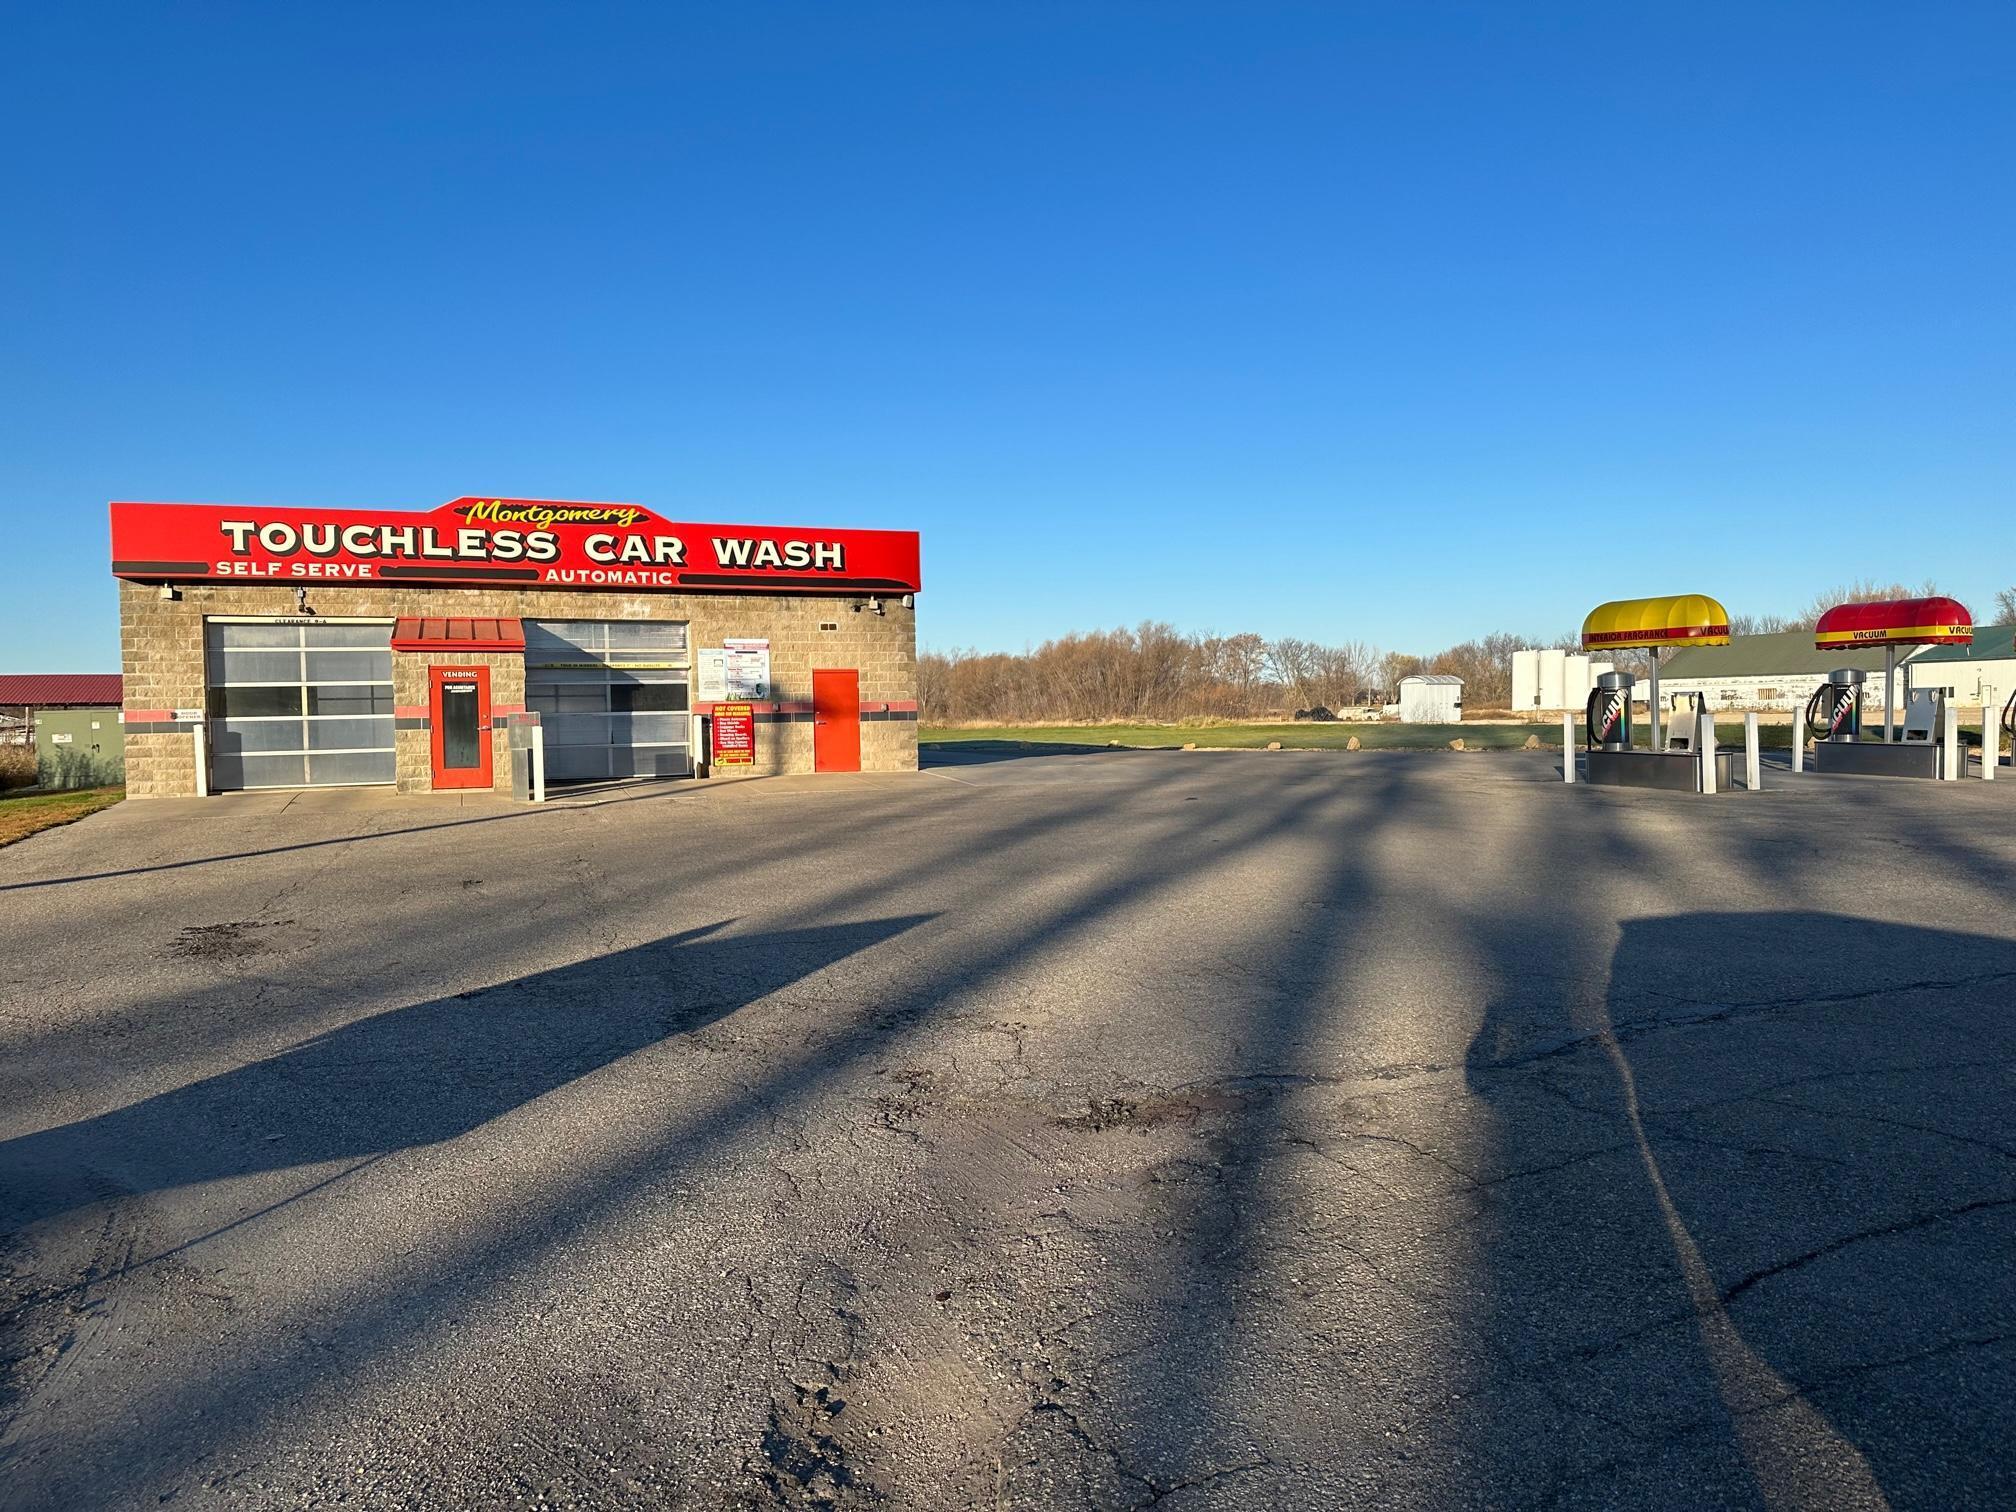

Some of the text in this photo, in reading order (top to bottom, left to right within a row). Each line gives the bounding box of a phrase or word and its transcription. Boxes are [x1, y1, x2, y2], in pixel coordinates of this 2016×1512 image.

[465, 500, 640, 529] Montgomery
[220, 520, 843, 568] TOUCHLESS CAR WASH
[216, 561, 372, 577] SELF SERVE
[545, 568, 673, 585] AUTOMATIC
[1588, 632, 1621, 642] INTERIOR
[1853, 630, 1887, 639] VACUUM
